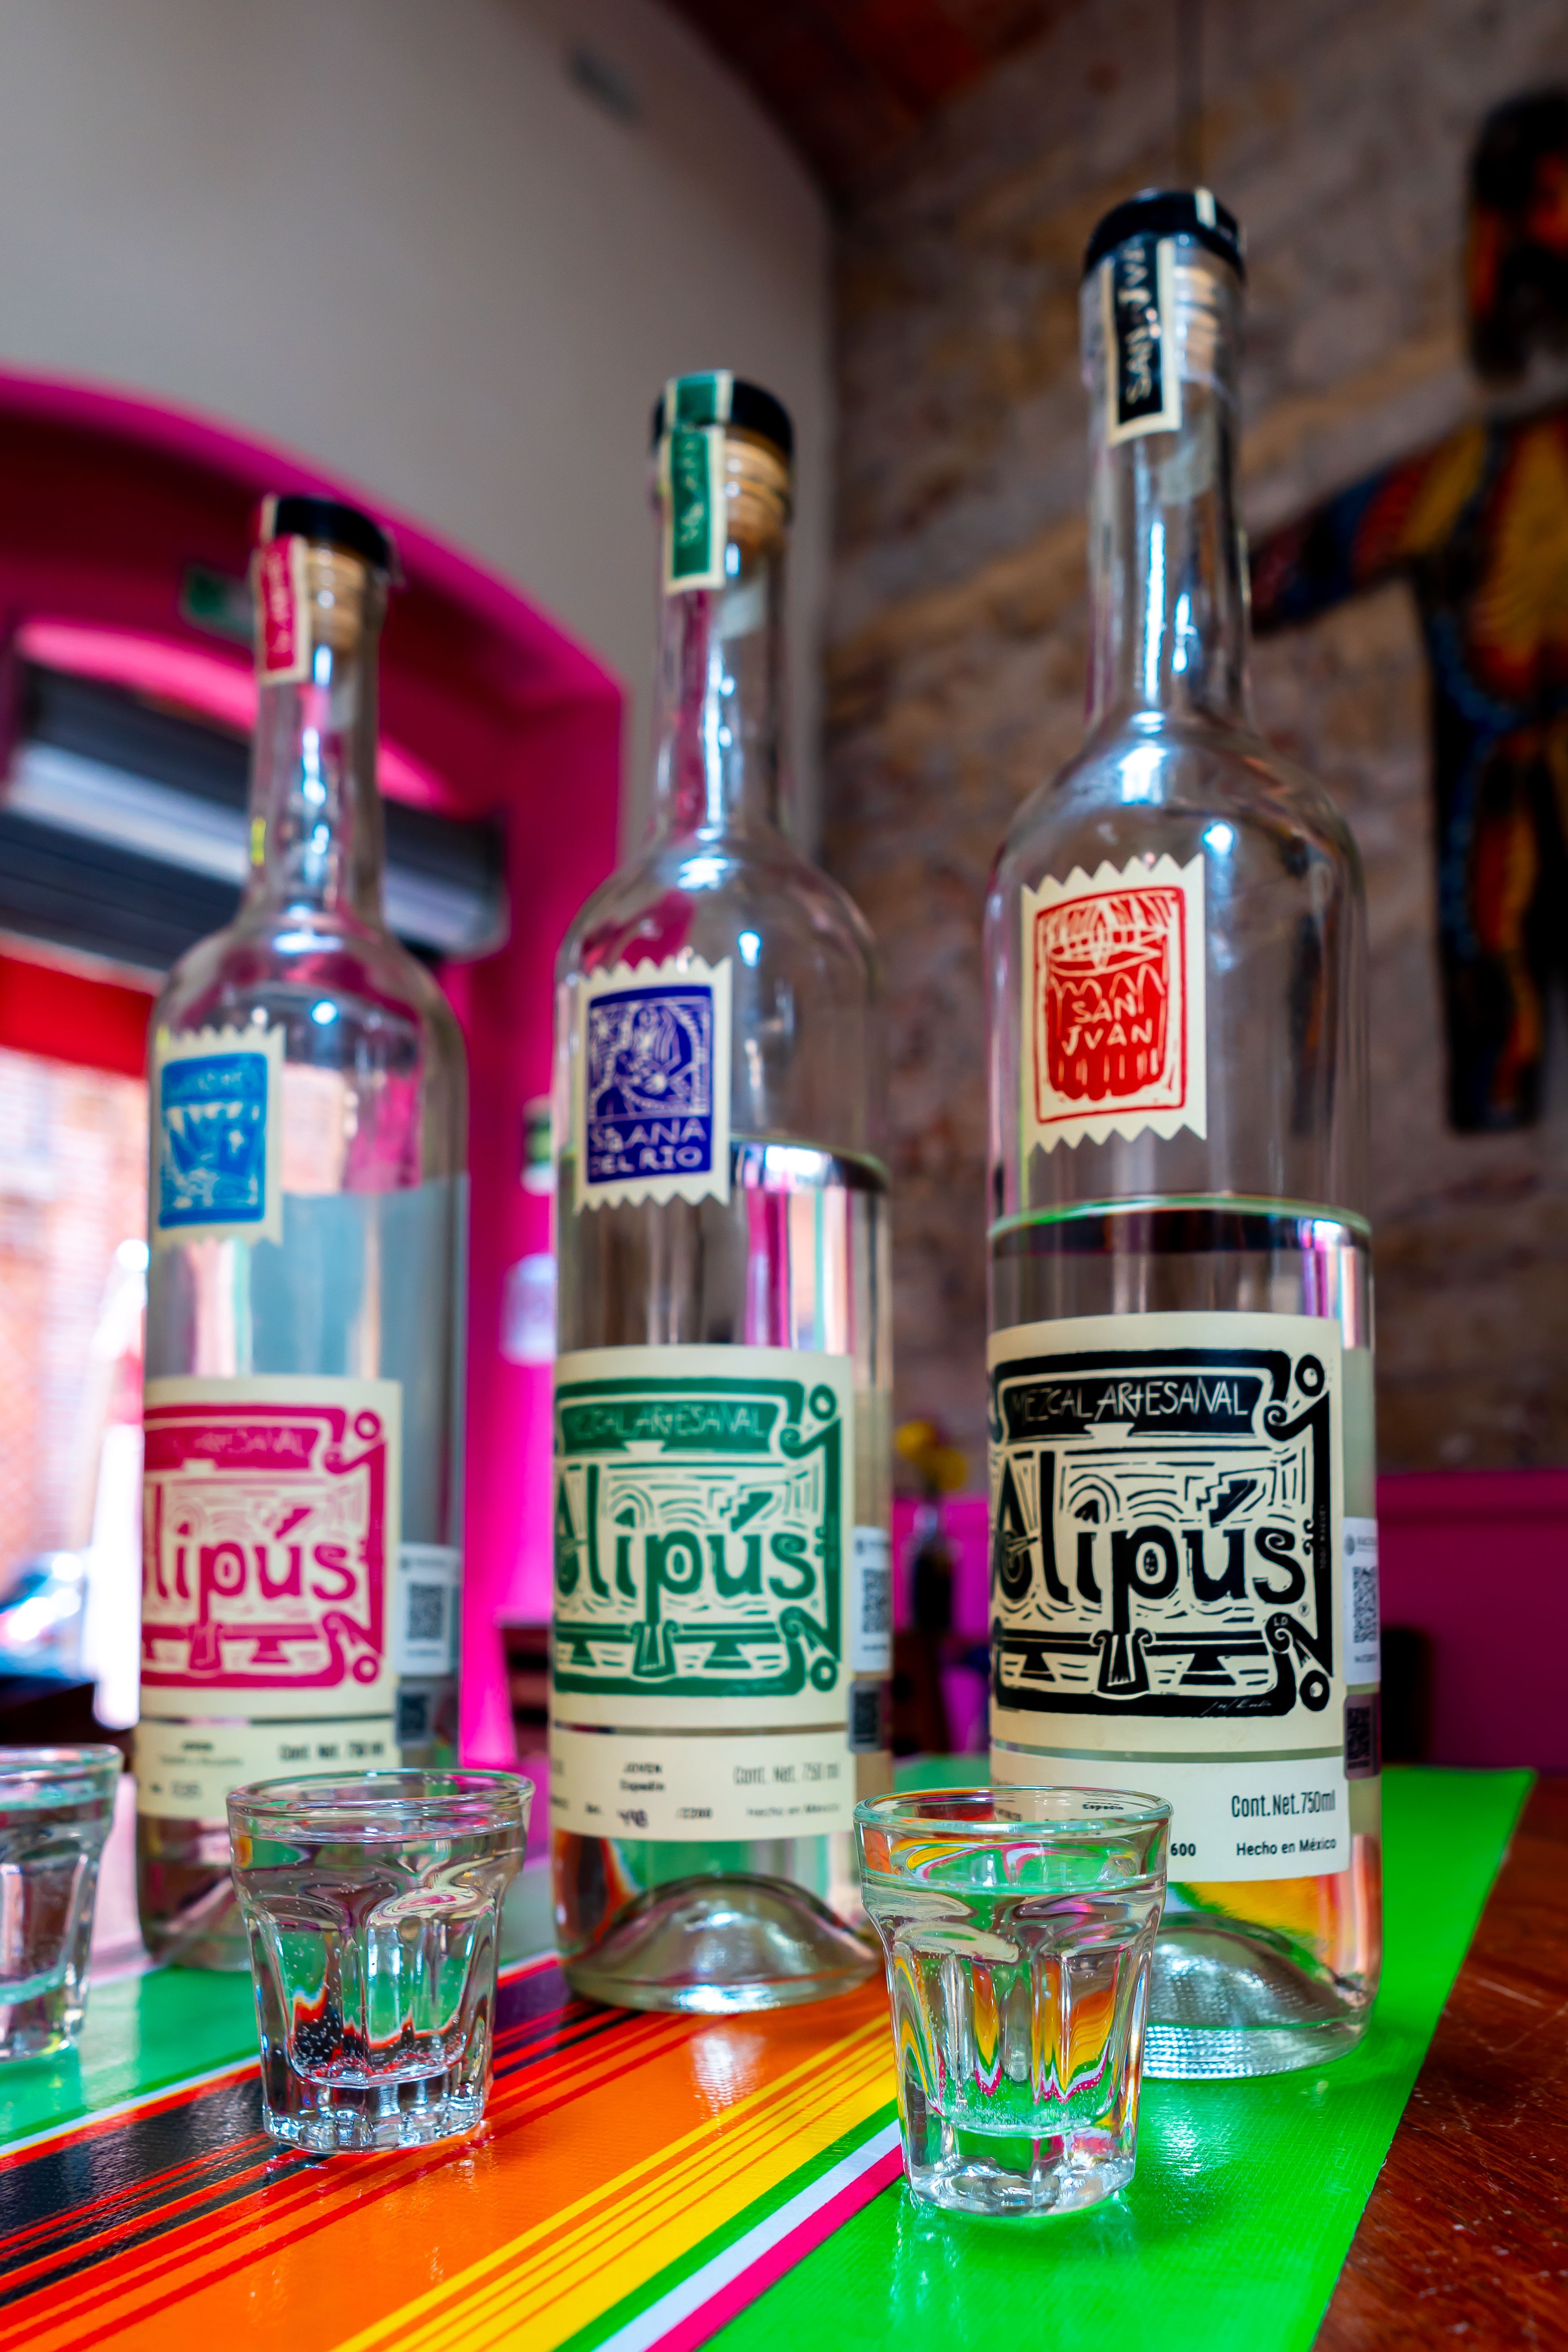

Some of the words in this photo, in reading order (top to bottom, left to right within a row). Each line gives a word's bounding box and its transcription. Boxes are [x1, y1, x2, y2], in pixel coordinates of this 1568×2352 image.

[1070, 992, 1137, 1025] SAN
[638, 1144, 703, 1171] RIO
[1011, 1387, 1094, 1422] MEZCAL
[1236, 1841, 1278, 1856] Hecho
[1281, 1842, 1296, 1854] en
